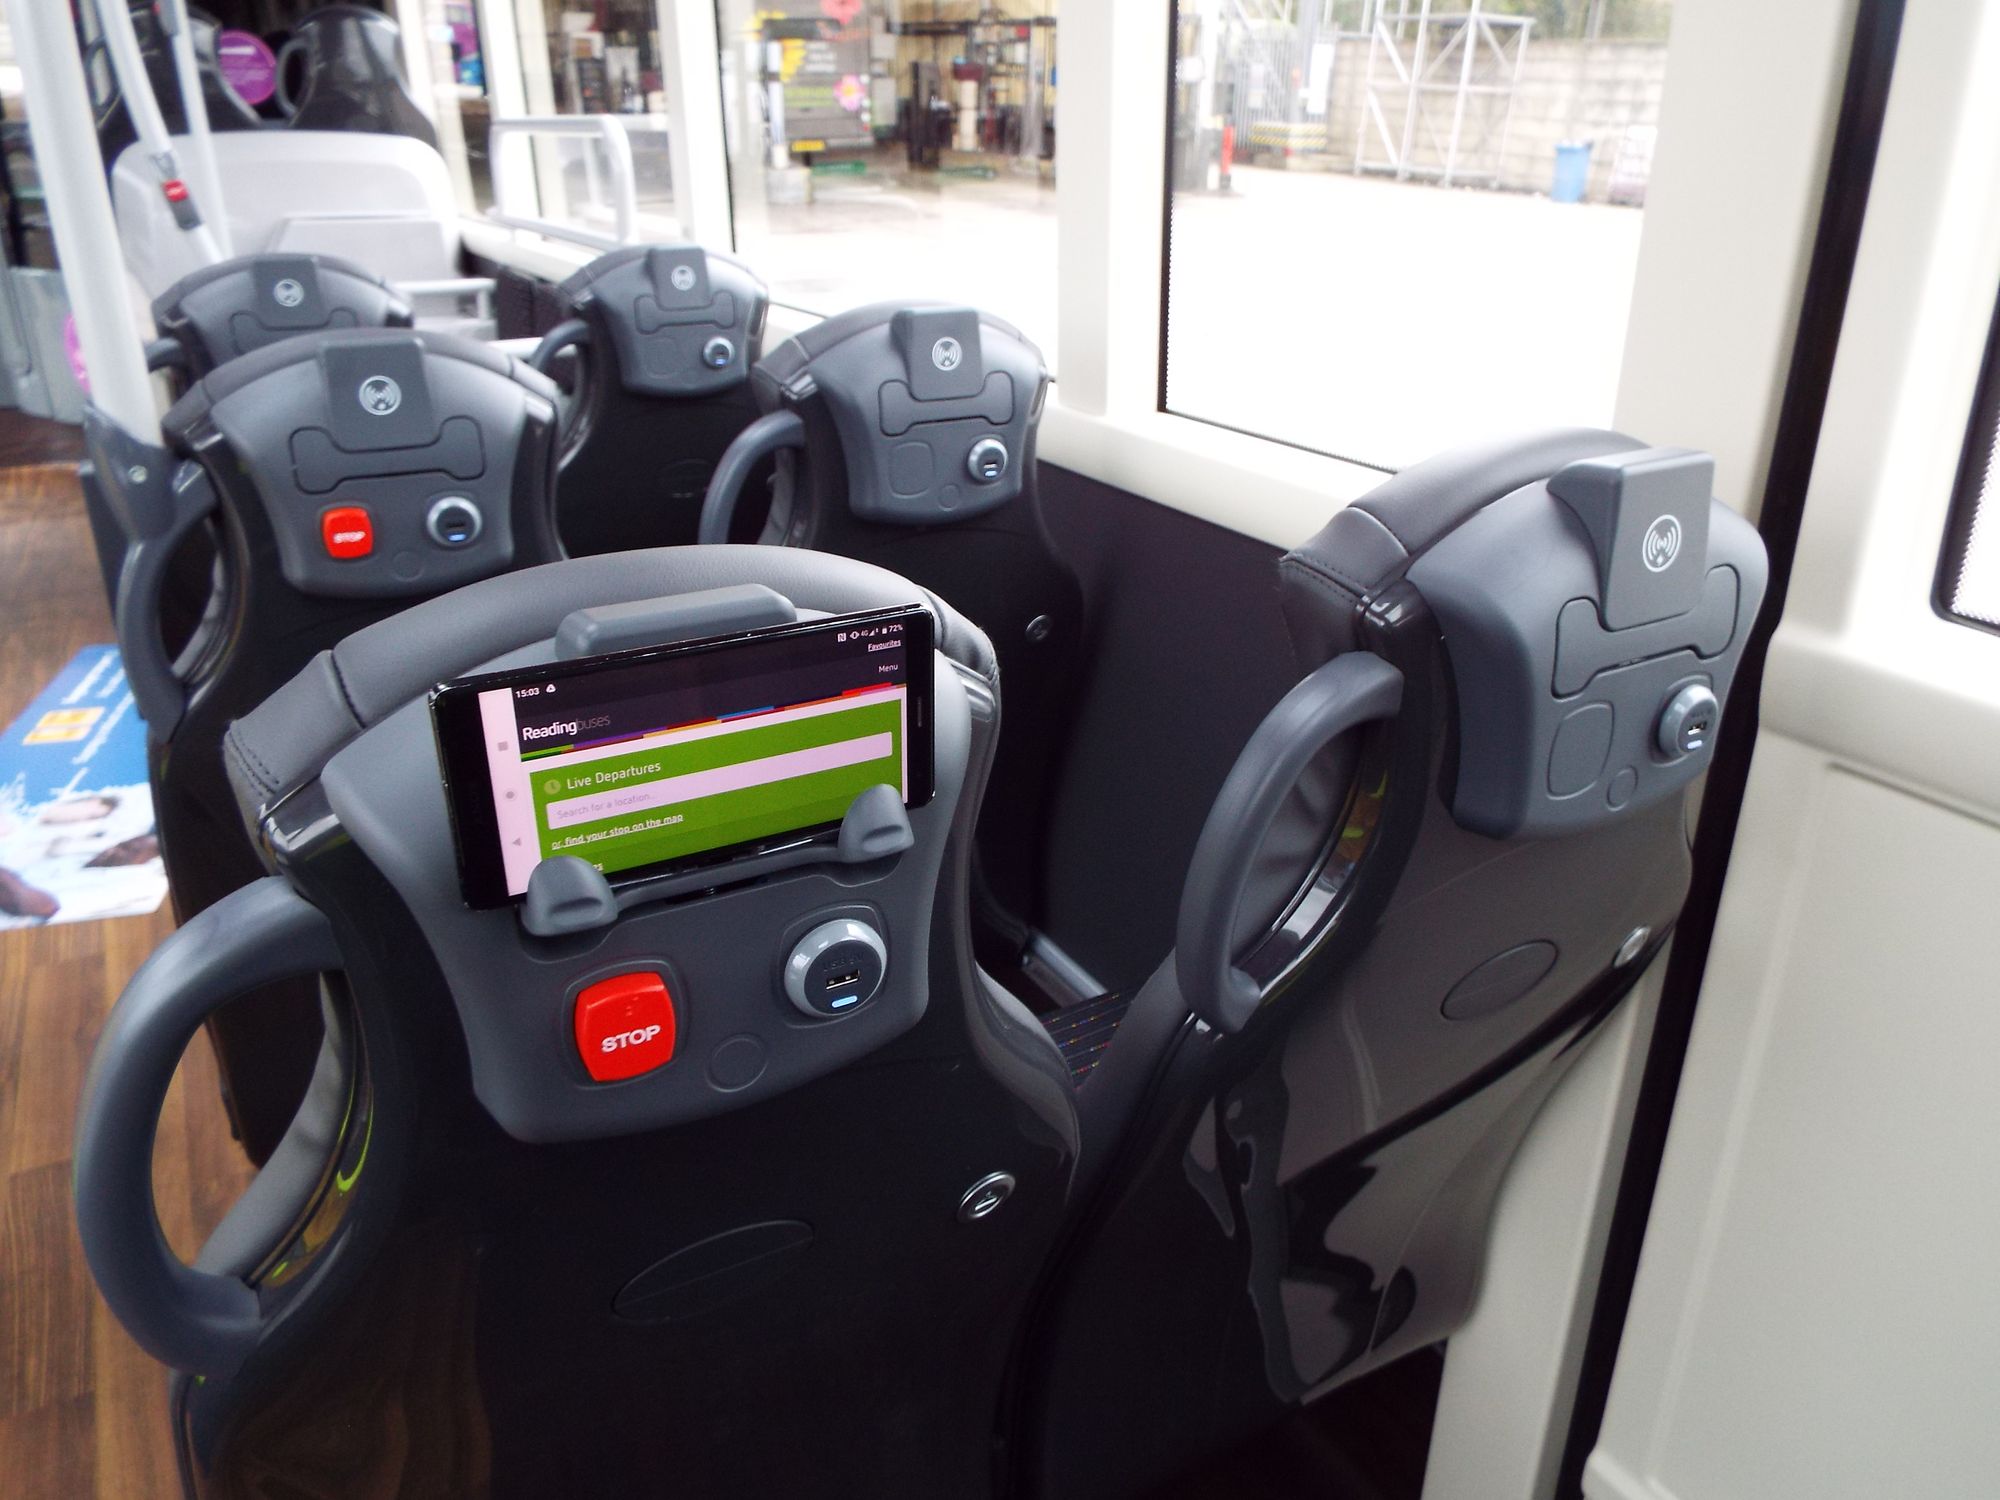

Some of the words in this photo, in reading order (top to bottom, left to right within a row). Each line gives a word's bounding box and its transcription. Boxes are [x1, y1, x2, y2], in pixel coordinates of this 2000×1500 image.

[888, 624, 903, 633] 72%
[868, 640, 901, 652] Favourites
[878, 664, 898, 673] Menu
[515, 687, 540, 698] 15:03
[566, 777, 592, 790] Live
[595, 761, 661, 784] Departures
[557, 805, 588, 819] Search
[591, 803, 603, 812] for
[606, 801, 612, 809] a
[552, 840, 561, 850] or
[565, 834, 584, 846] find
[586, 830, 608, 843] your
[610, 825, 631, 836] stop
[632, 822, 644, 832] on
[646, 818, 661, 829] the
[663, 814, 684, 825] map
[601, 1024, 661, 1053] STOP
